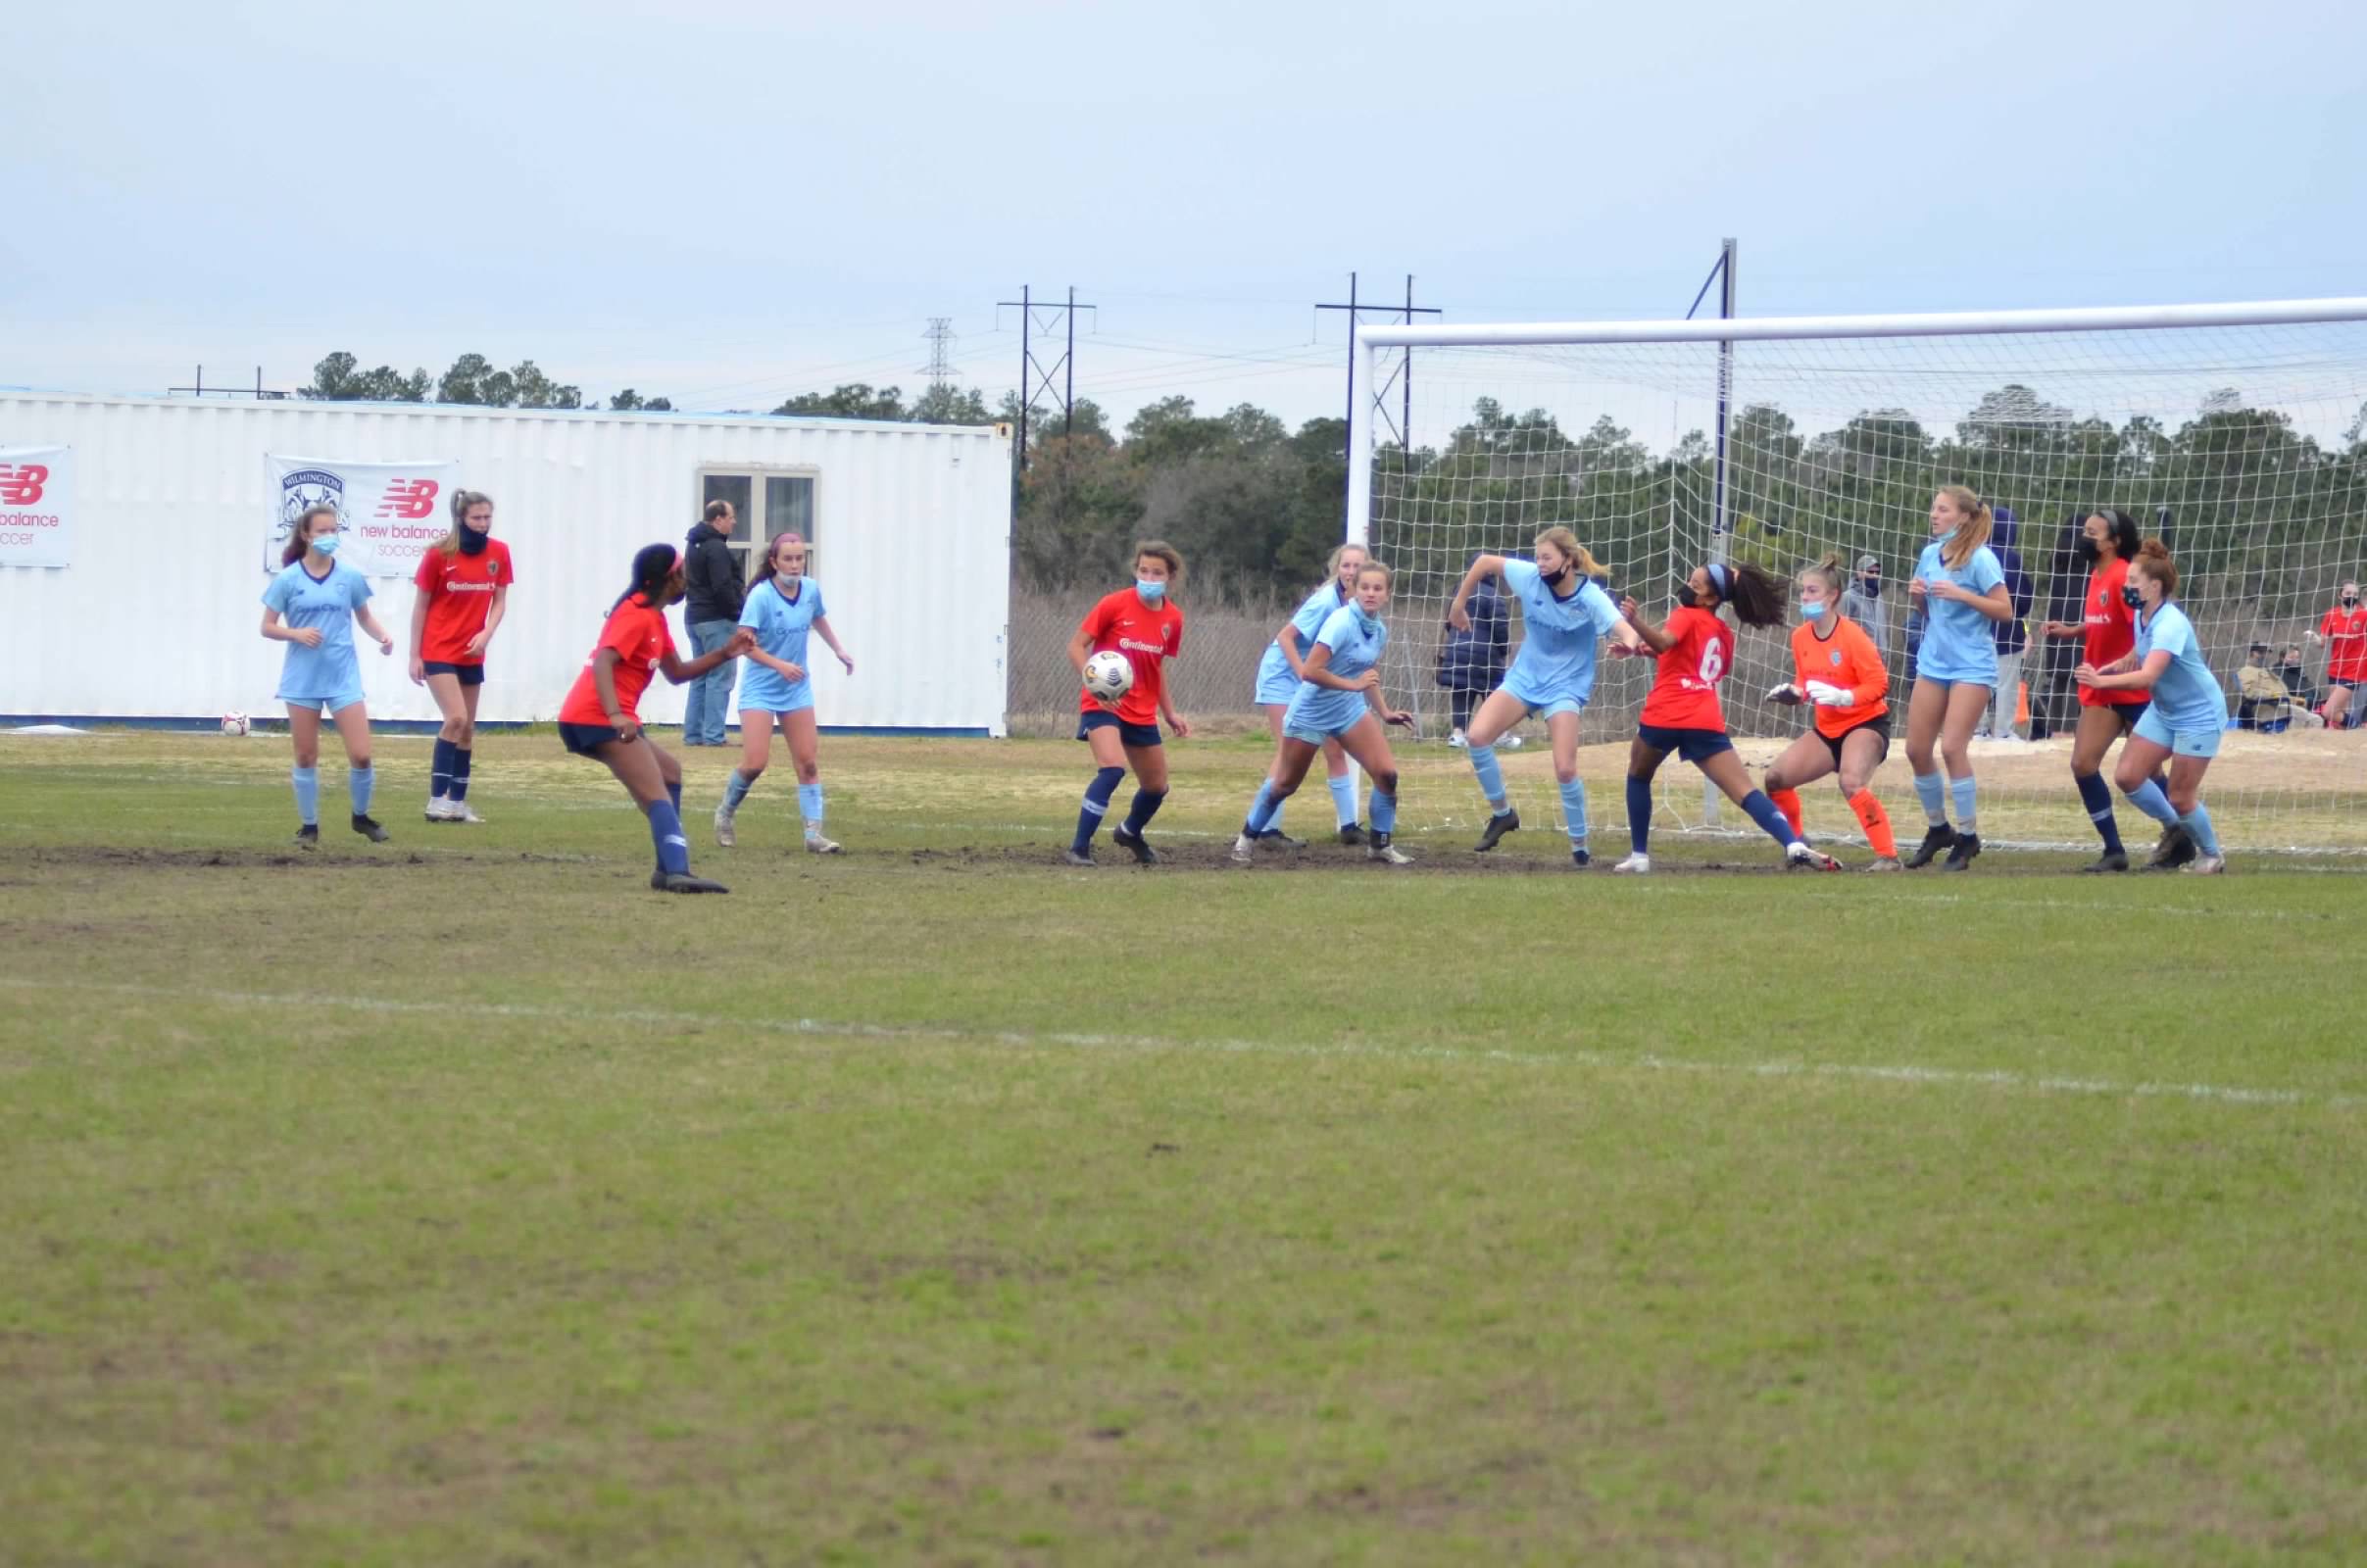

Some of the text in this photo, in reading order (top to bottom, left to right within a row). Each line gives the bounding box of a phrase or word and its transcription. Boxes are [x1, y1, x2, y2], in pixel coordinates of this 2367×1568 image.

[283, 473, 342, 490] WILMINGTON
[360, 524, 448, 539] new balance
[377, 543, 424, 557] socce
[1699, 636, 1722, 683] 6
